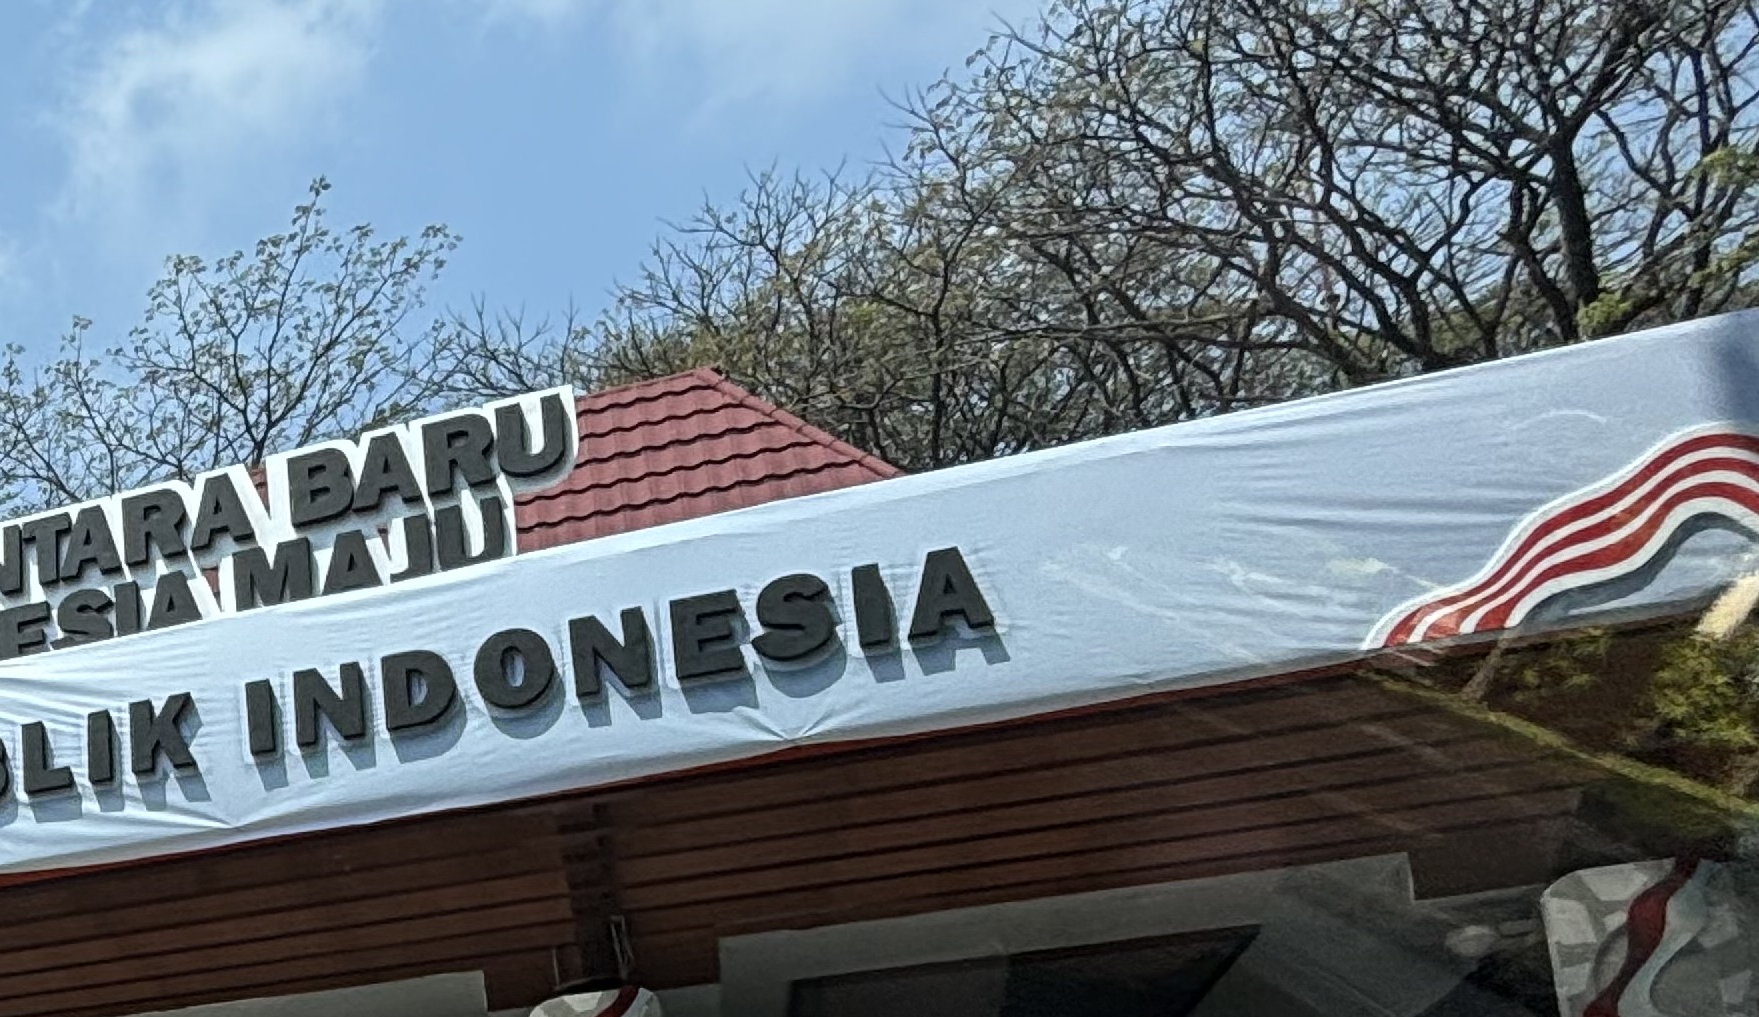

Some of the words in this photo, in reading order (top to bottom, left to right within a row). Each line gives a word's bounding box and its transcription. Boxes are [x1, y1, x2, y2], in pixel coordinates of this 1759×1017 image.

[287, 393, 567, 528] BARU
[232, 496, 507, 611] MAJU
[244, 546, 997, 756] INDONESIA
